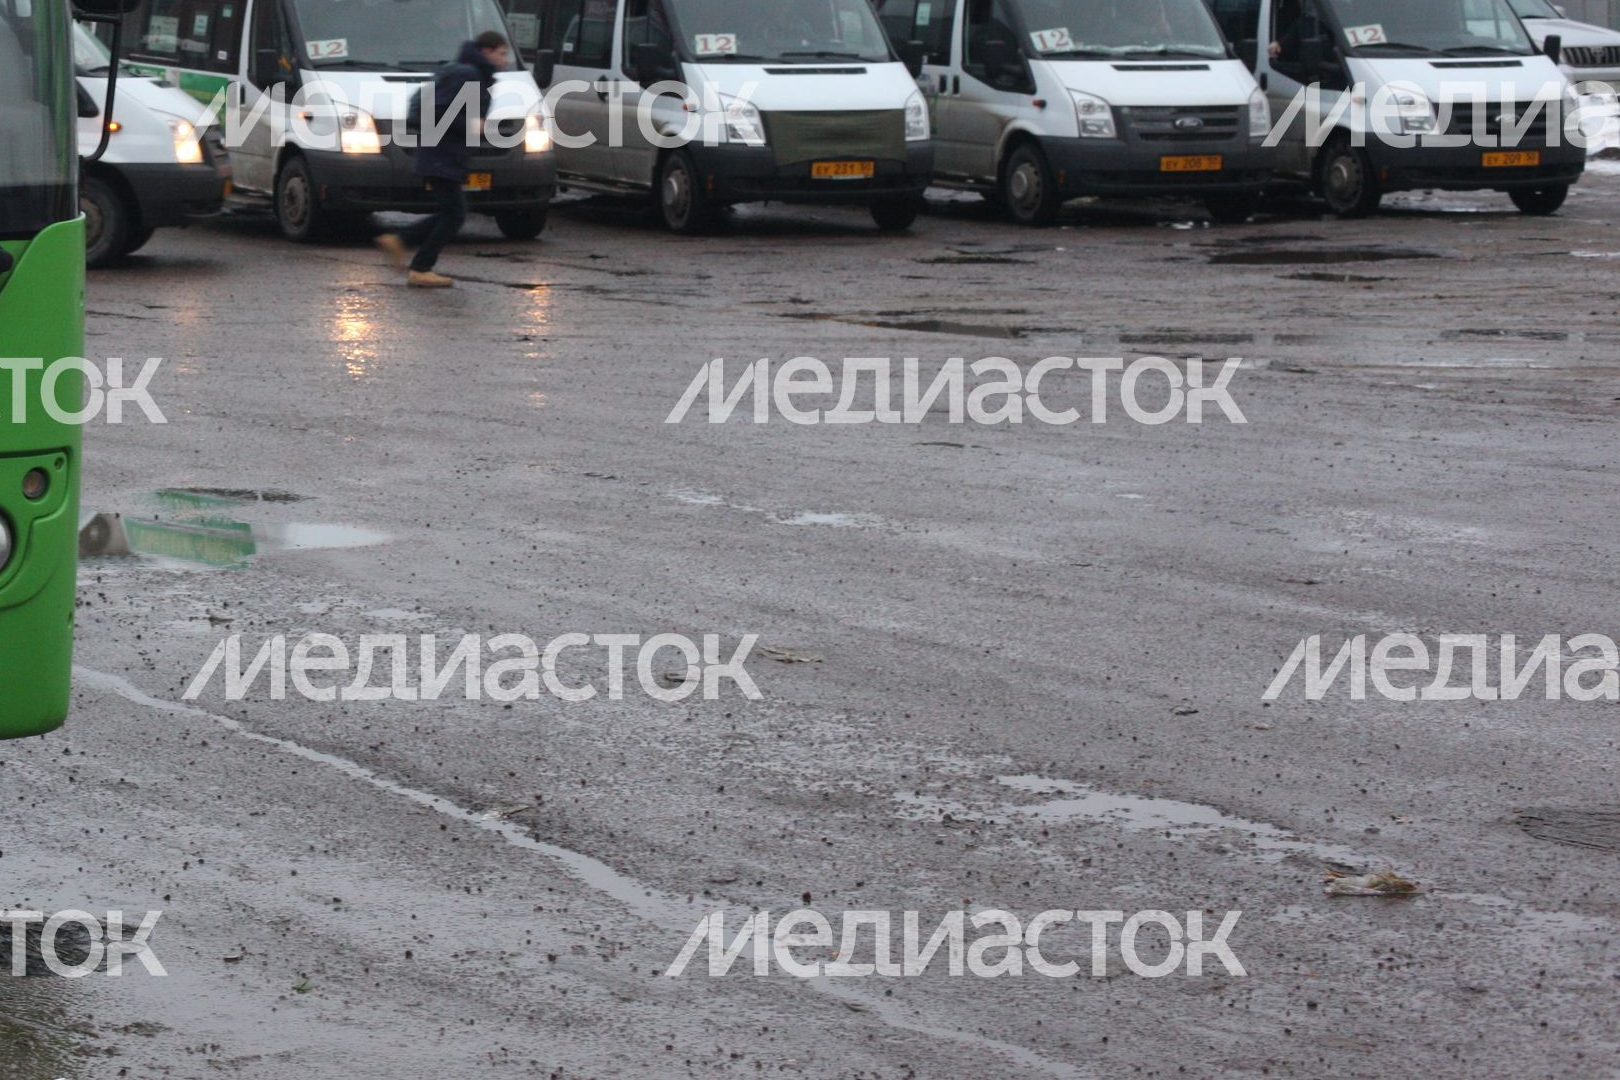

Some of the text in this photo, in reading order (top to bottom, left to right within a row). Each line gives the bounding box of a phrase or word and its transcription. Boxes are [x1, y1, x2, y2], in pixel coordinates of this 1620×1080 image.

[698, 36, 732, 52] 12
[1035, 30, 1070, 50] 12
[1347, 27, 1383, 45] 12
[309, 41, 346, 58] 12
